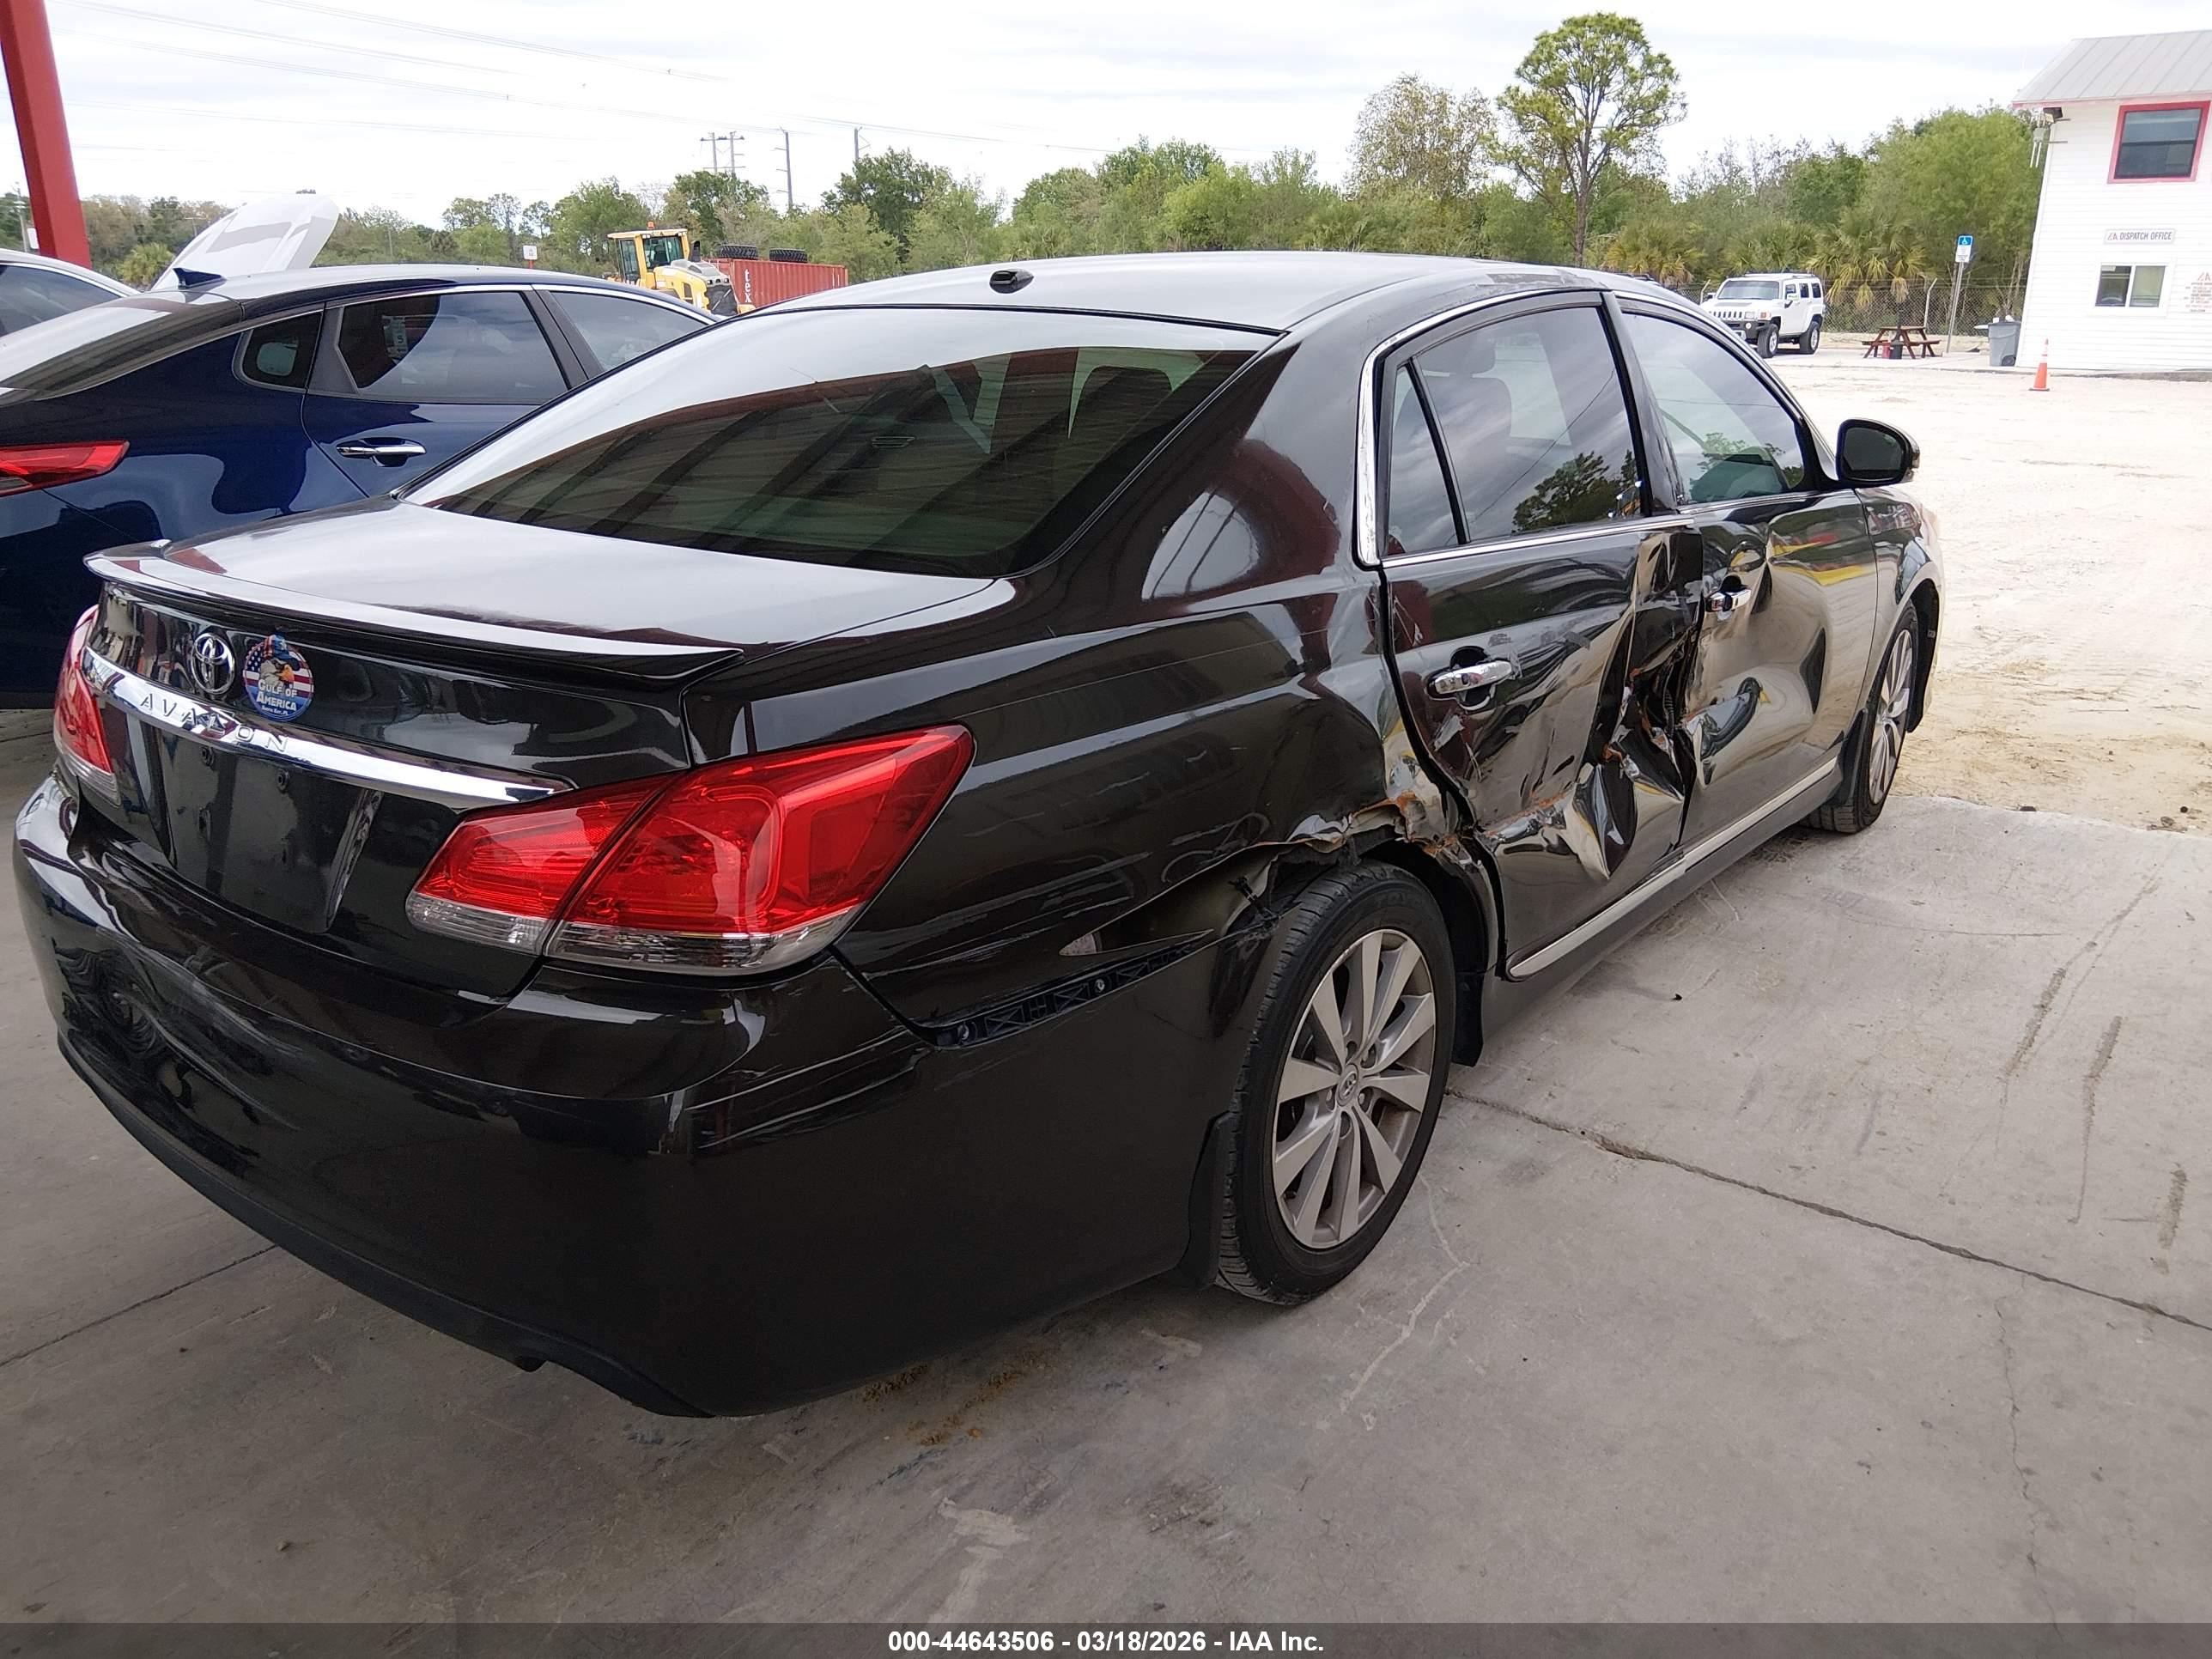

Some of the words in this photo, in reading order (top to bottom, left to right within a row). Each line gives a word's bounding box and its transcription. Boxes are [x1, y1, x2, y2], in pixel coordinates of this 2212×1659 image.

[2119, 231, 2149, 240] DISPATCH
[2150, 231, 2172, 240] OFFICE
[744, 268, 753, 303] tex
[258, 678, 283, 695] GULF
[285, 687, 298, 697] OF
[256, 690, 297, 711] AMERICA
[139, 692, 289, 752] AVALON
